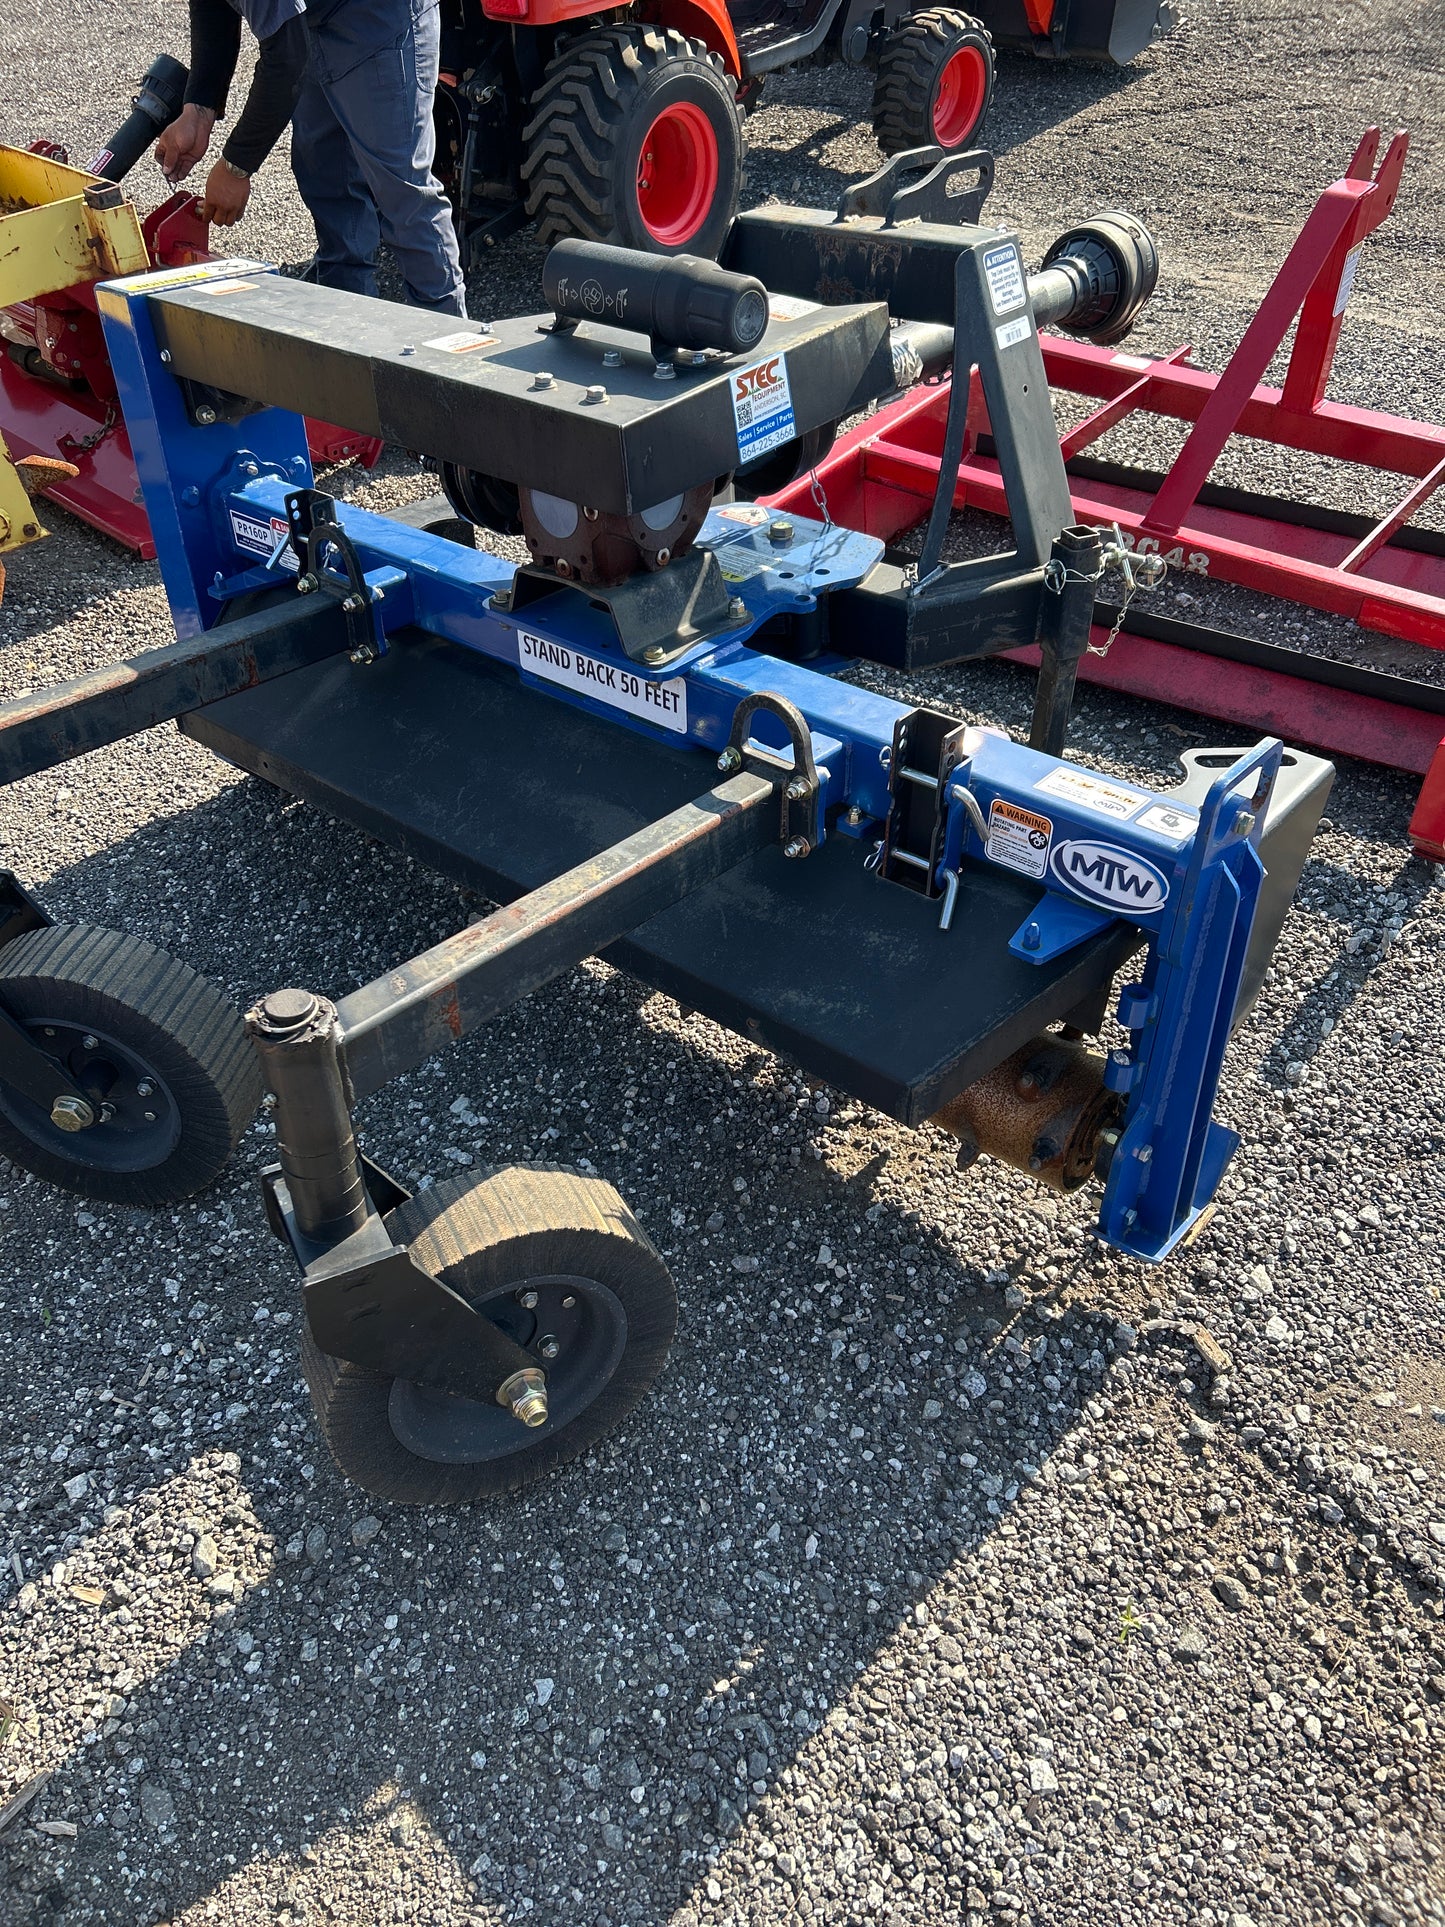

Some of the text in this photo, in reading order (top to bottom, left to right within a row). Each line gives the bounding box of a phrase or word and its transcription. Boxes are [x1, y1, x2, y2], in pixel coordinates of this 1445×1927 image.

[736, 358, 779, 402] STEC
[754, 382, 786, 402] EQUIPMENT
[739, 432, 753, 443] Sales
[756, 420, 776, 435] Service
[779, 412, 793, 424] Parts
[741, 425, 794, 459] 864-225-3666
[237, 521, 268, 541] PR160P
[523, 634, 680, 714] STAND BACK 50 FEET
[1006, 807, 1047, 831] WARNING
[1070, 851, 1155, 899] MTW
